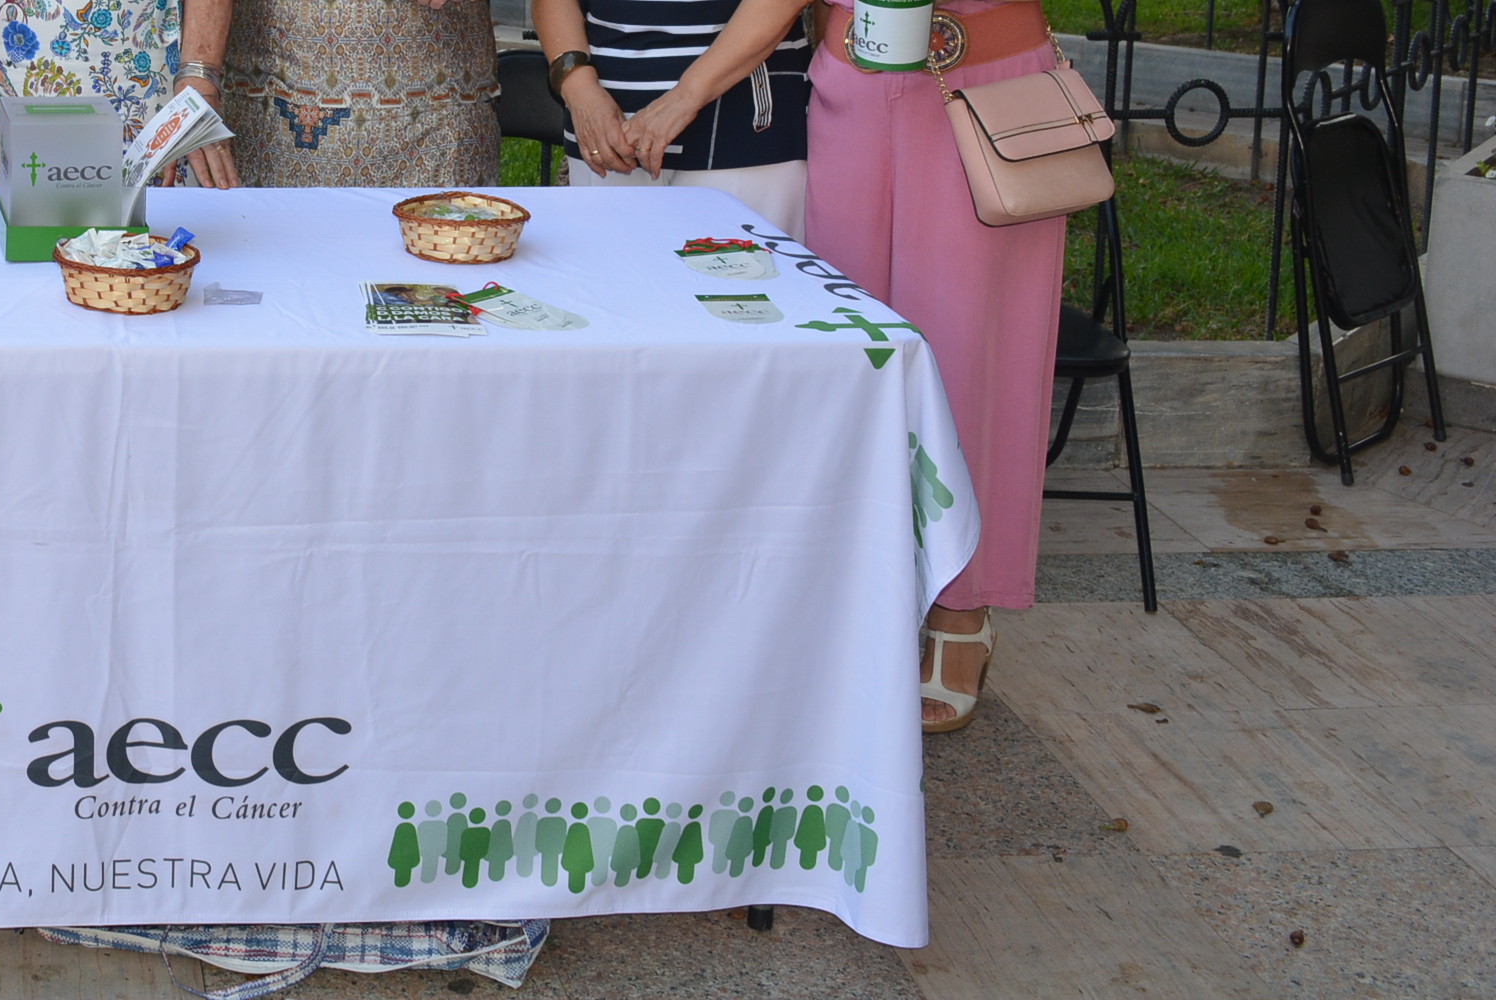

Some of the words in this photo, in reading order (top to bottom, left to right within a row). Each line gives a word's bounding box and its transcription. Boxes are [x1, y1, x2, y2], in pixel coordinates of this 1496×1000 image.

[47, 165, 113, 182] aecc
[26, 716, 353, 789] aecc
[73, 793, 162, 821] Contra
[174, 795, 197, 819] el
[211, 793, 304, 822] Cáncer
[50, 857, 242, 894] NUESTRA
[254, 859, 345, 893] VIDA
